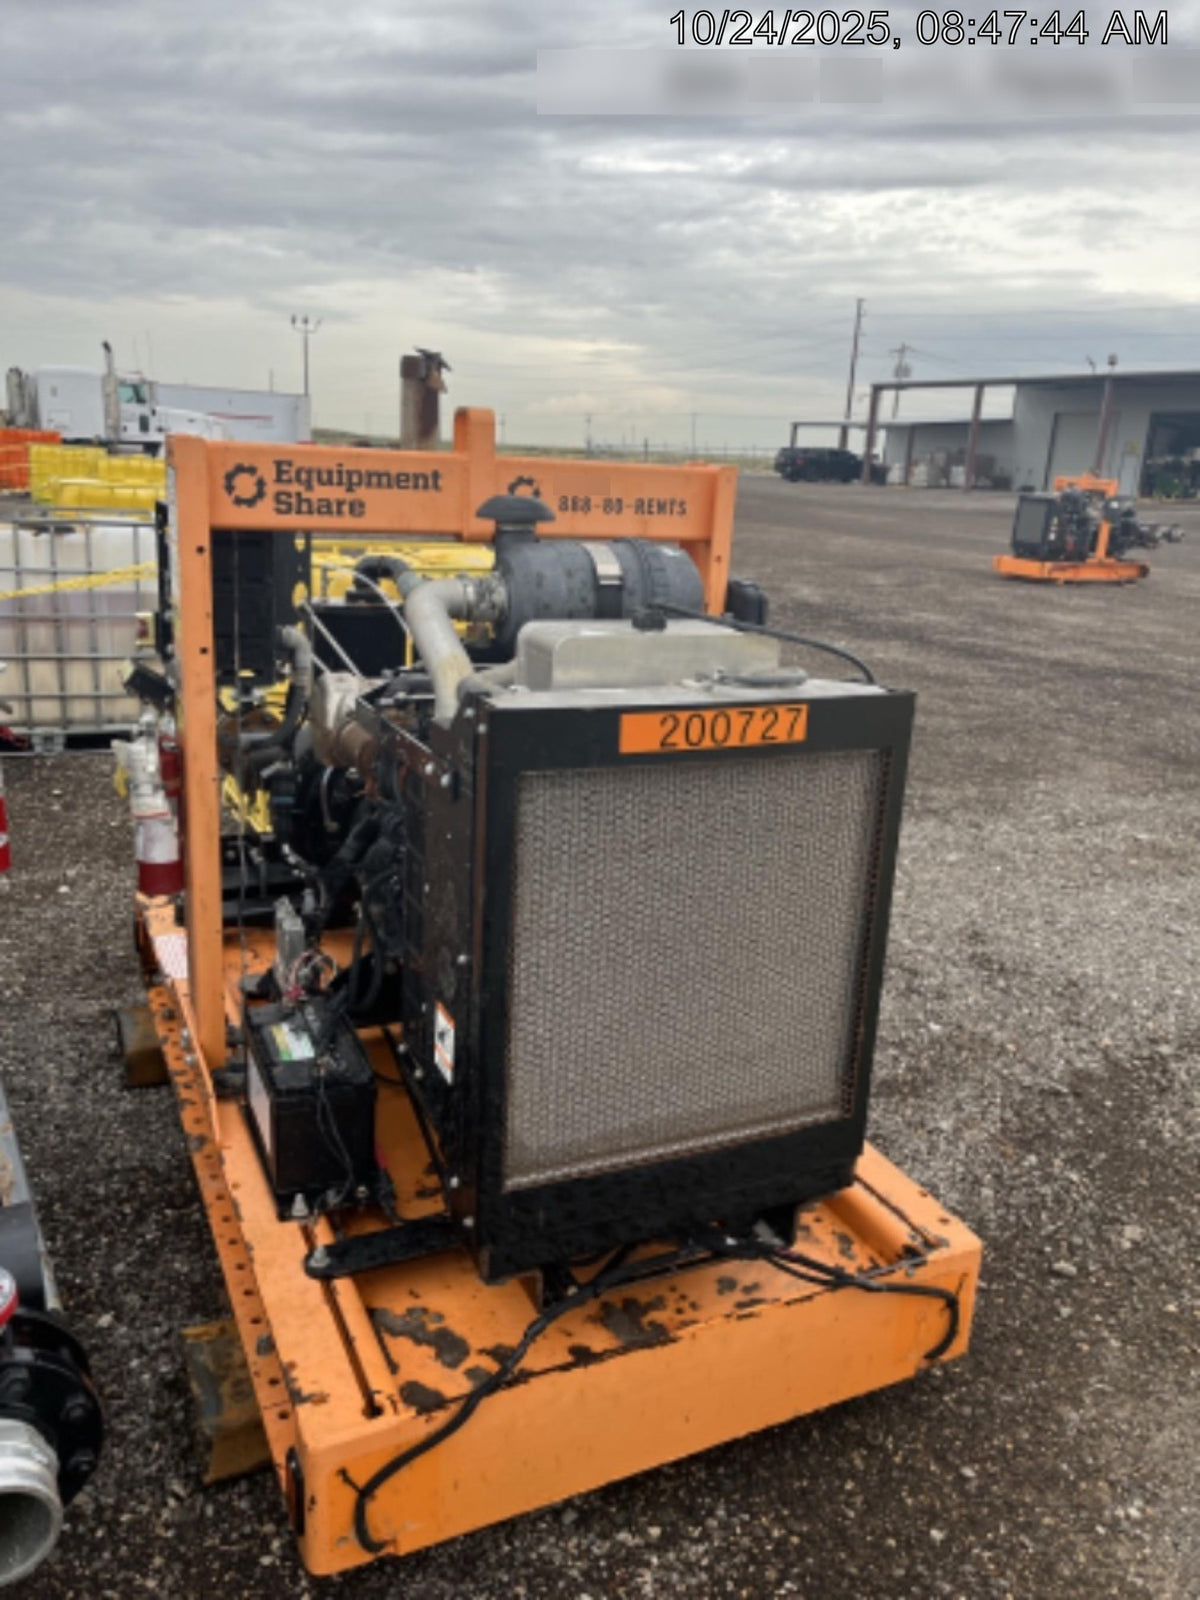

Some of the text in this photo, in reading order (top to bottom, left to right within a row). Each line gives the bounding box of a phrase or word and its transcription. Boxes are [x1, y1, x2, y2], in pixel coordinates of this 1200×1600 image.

[273, 460, 442, 492] Equipment
[274, 491, 366, 518] Share
[659, 706, 803, 748] 200727
